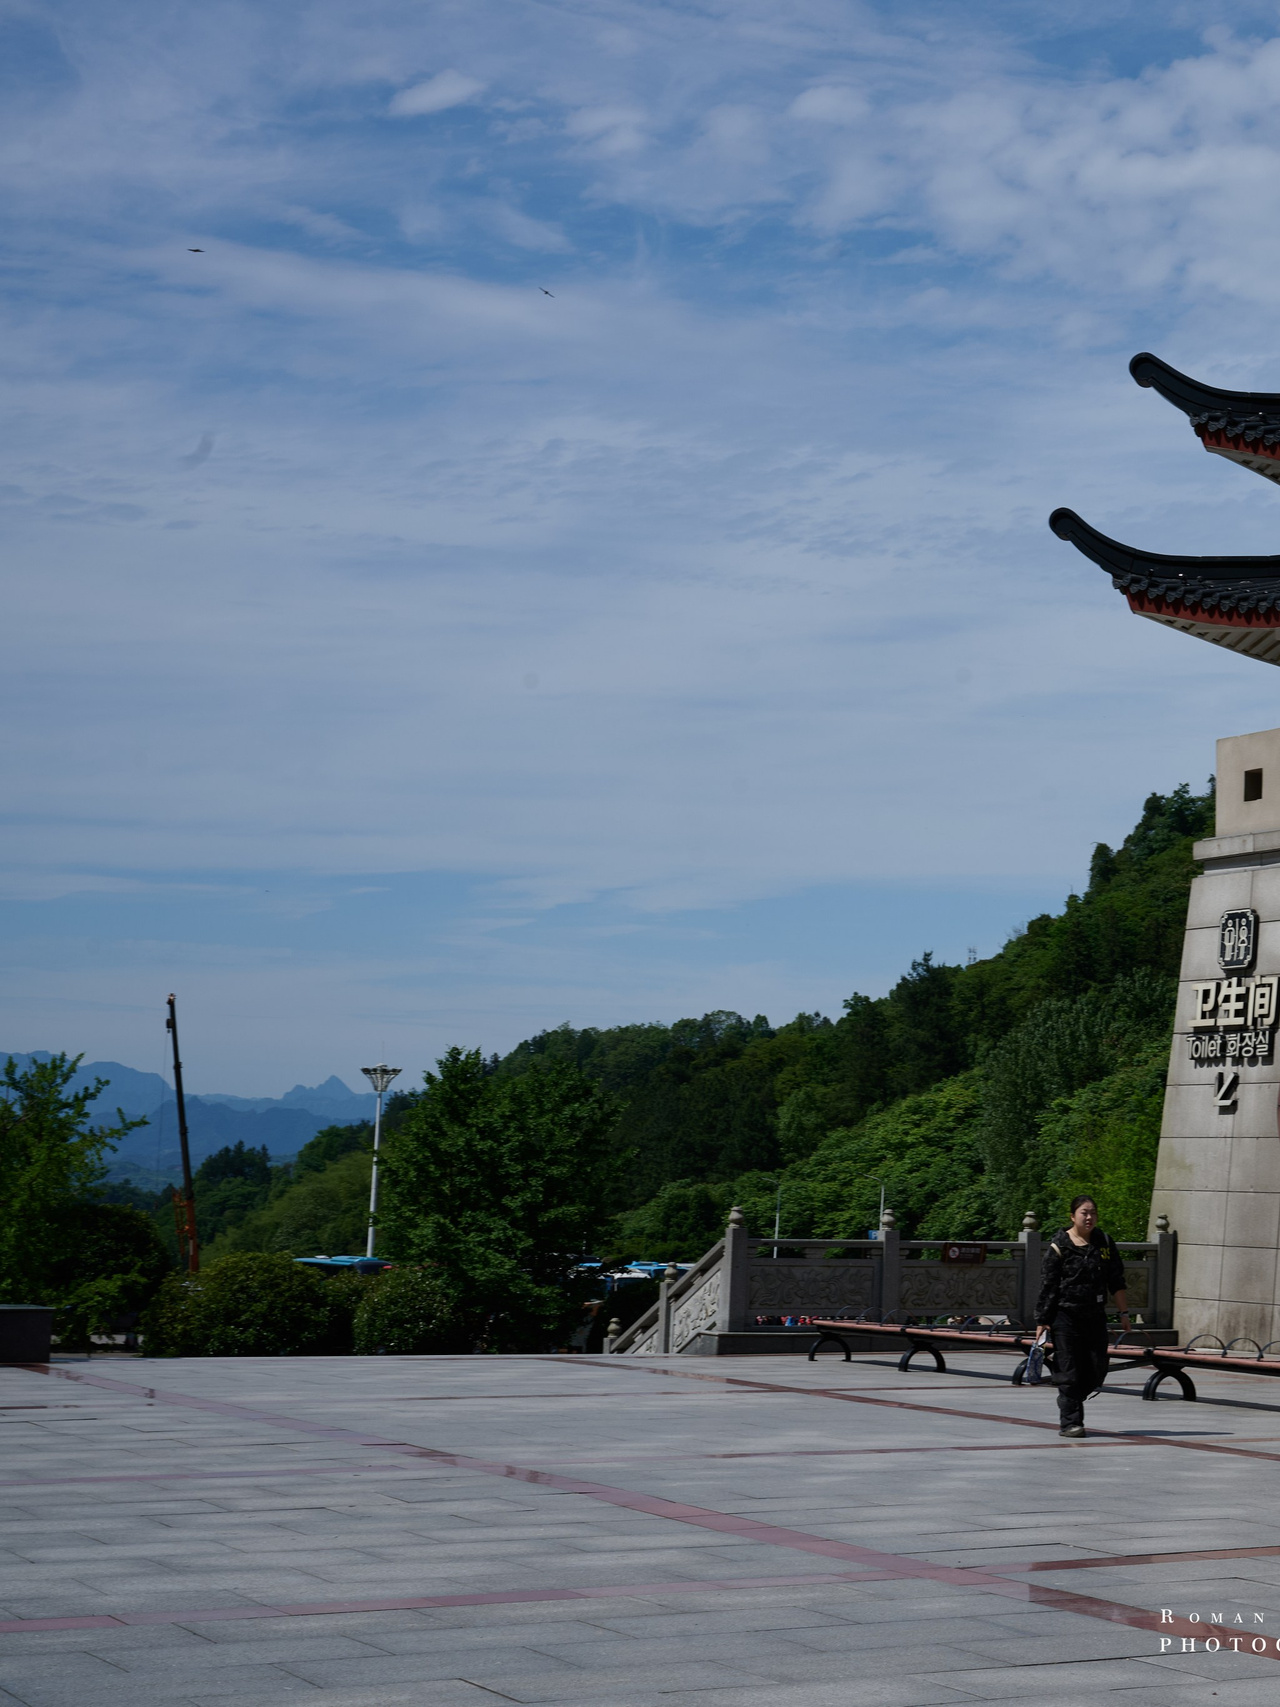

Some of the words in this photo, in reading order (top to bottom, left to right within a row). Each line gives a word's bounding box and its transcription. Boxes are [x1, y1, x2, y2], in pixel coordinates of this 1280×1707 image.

[1187, 975, 1279, 1028] 卫生间
[1186, 1034, 1222, 1059] Toilet
[1227, 1031, 1269, 1057] 화장실
